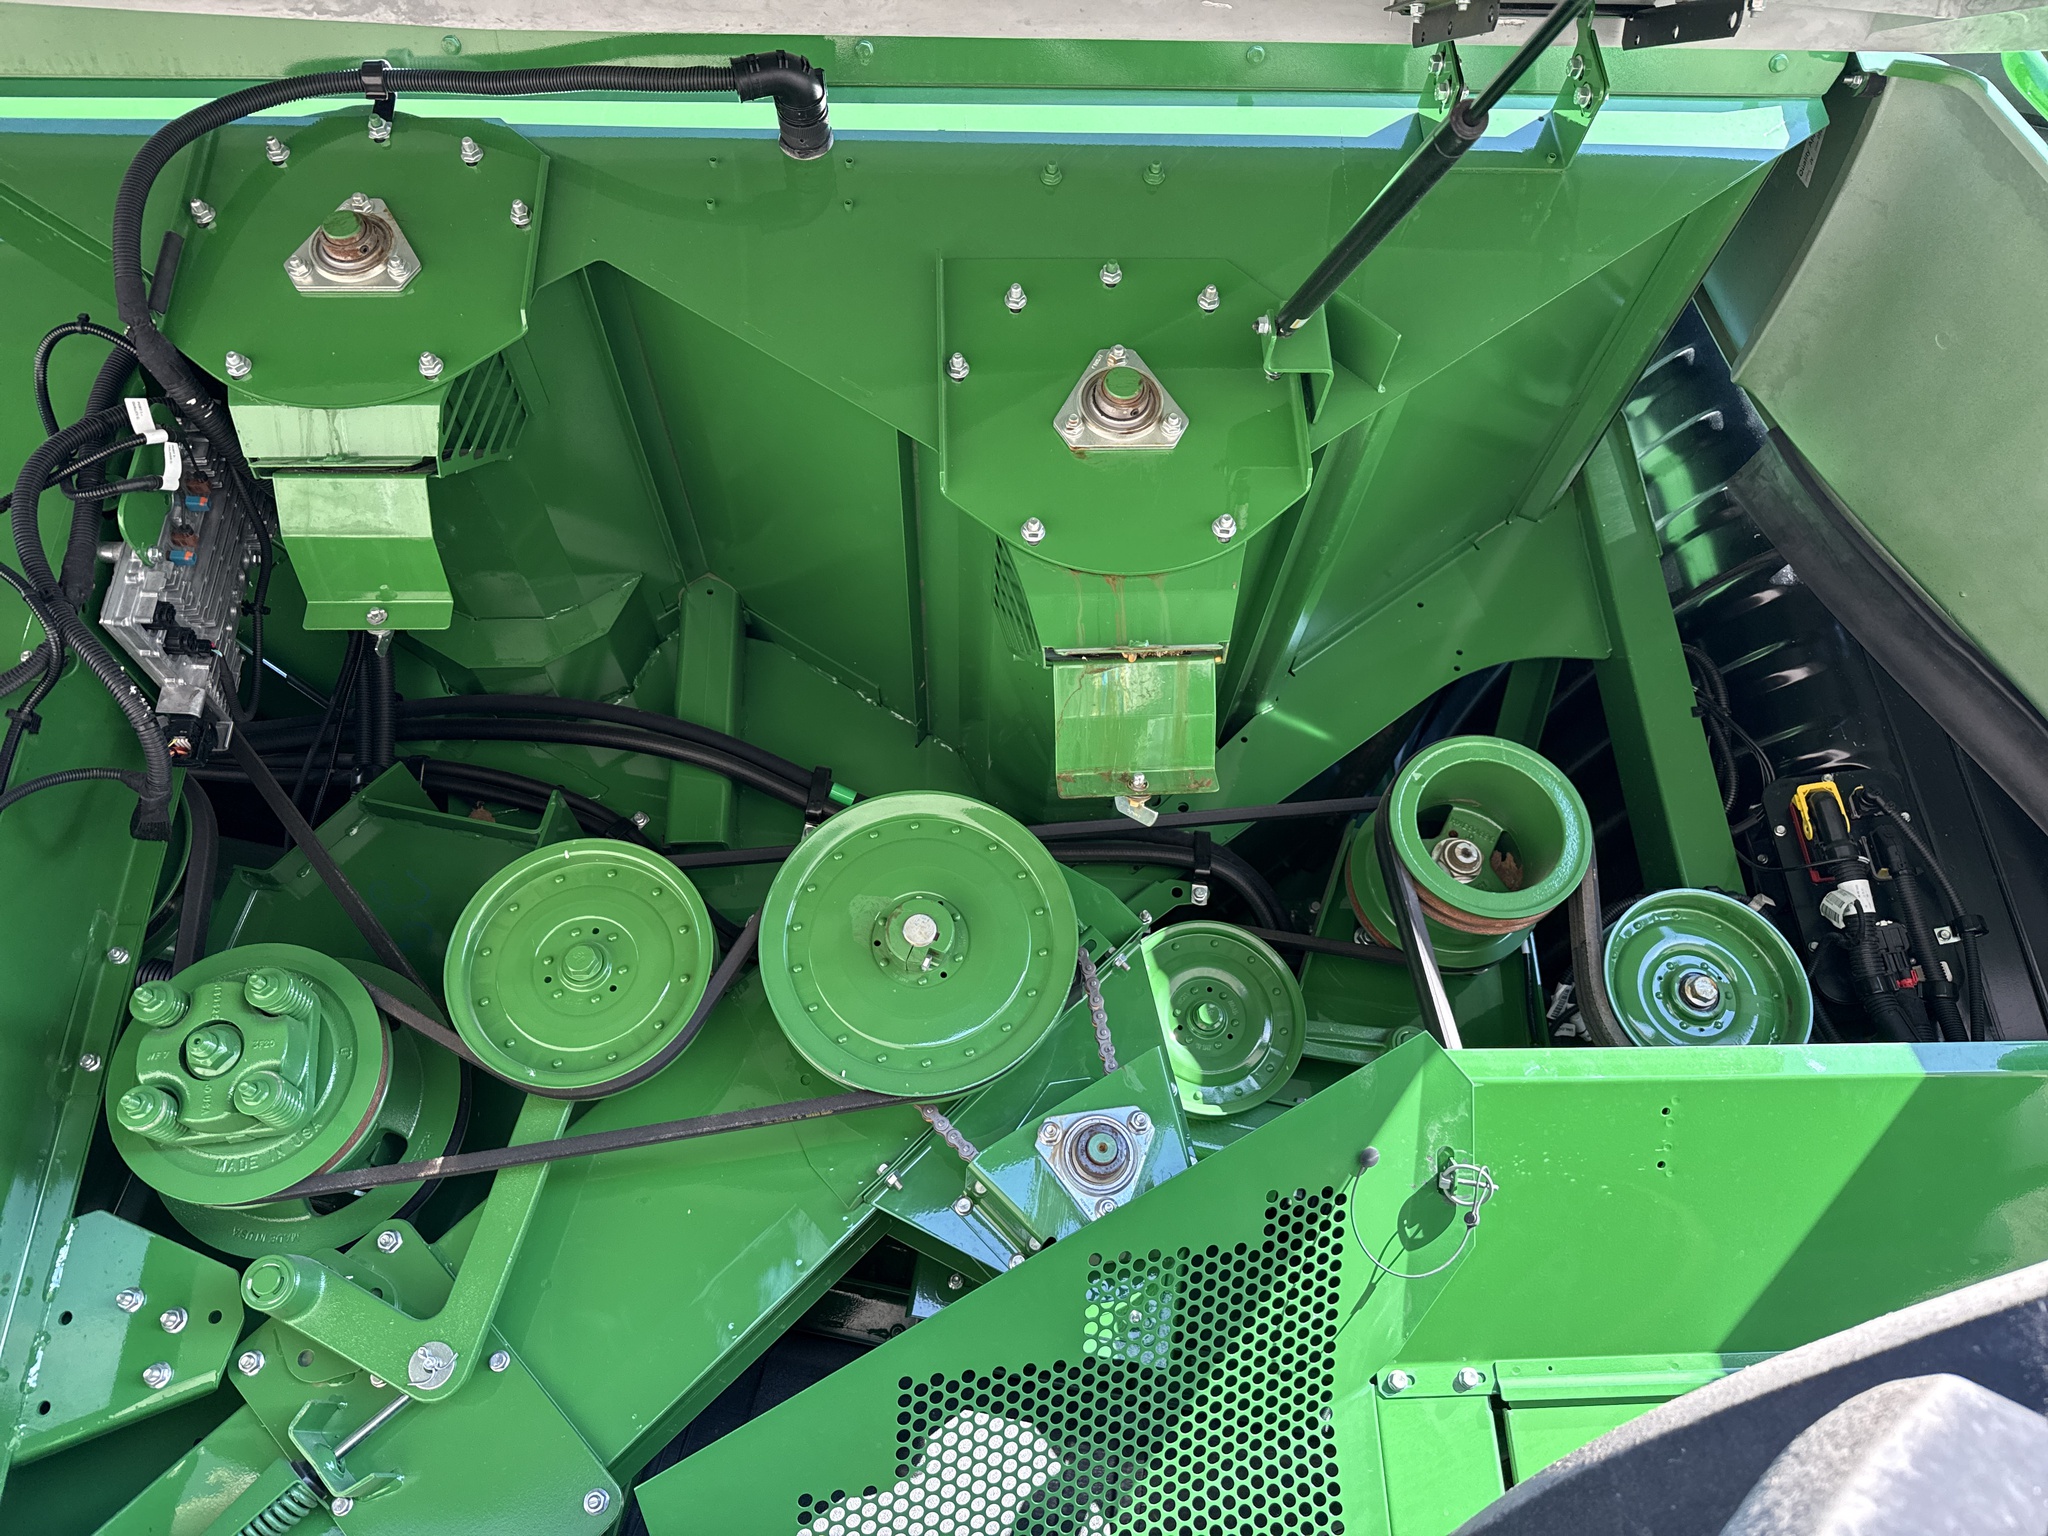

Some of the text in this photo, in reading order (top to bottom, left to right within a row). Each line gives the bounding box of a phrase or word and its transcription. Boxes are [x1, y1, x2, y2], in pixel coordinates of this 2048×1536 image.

[1798, 151, 1810, 177] Quality
[214, 1122, 323, 1173] MADE IN USA
[232, 1226, 254, 1241] USA
[268, 1232, 301, 1243] MADE
